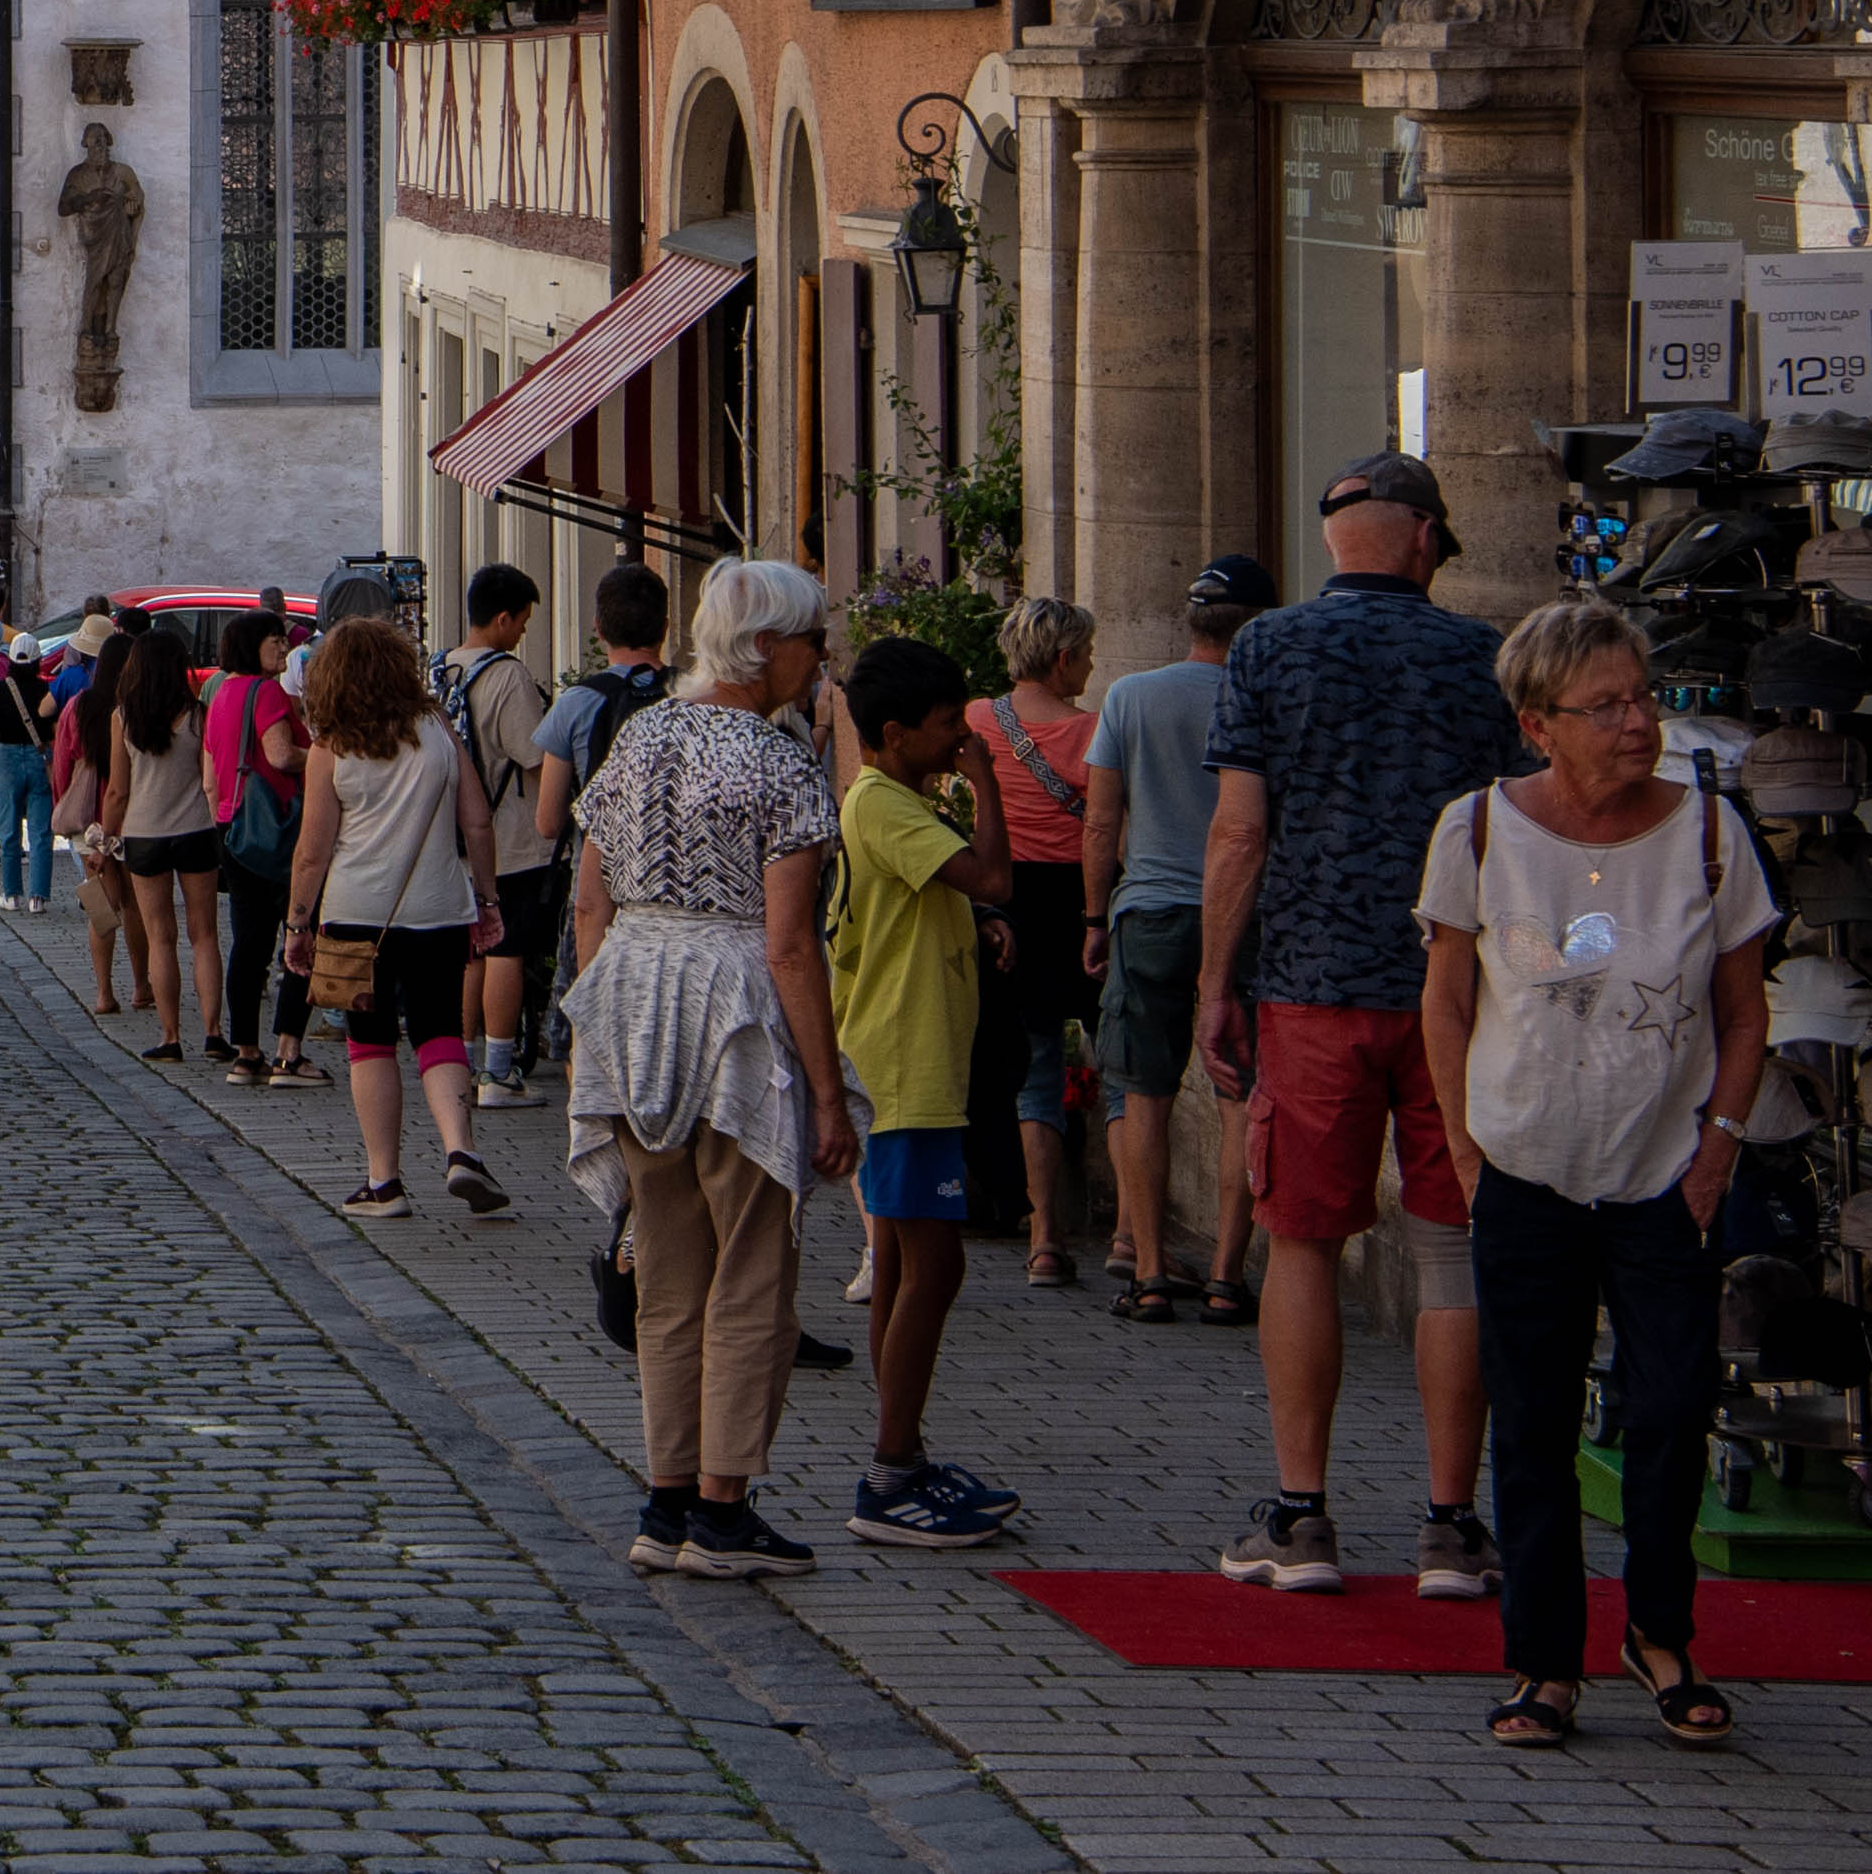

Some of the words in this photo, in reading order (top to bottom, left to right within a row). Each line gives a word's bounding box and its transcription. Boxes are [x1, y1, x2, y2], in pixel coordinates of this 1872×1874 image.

[1704, 128, 1775, 161] Schöne
[1283, 160, 1321, 179] POLICE
[1648, 299, 1726, 312] SONNENBRILLE
[1768, 310, 1827, 324] COTTON
[1829, 308, 1861, 322] CAP
